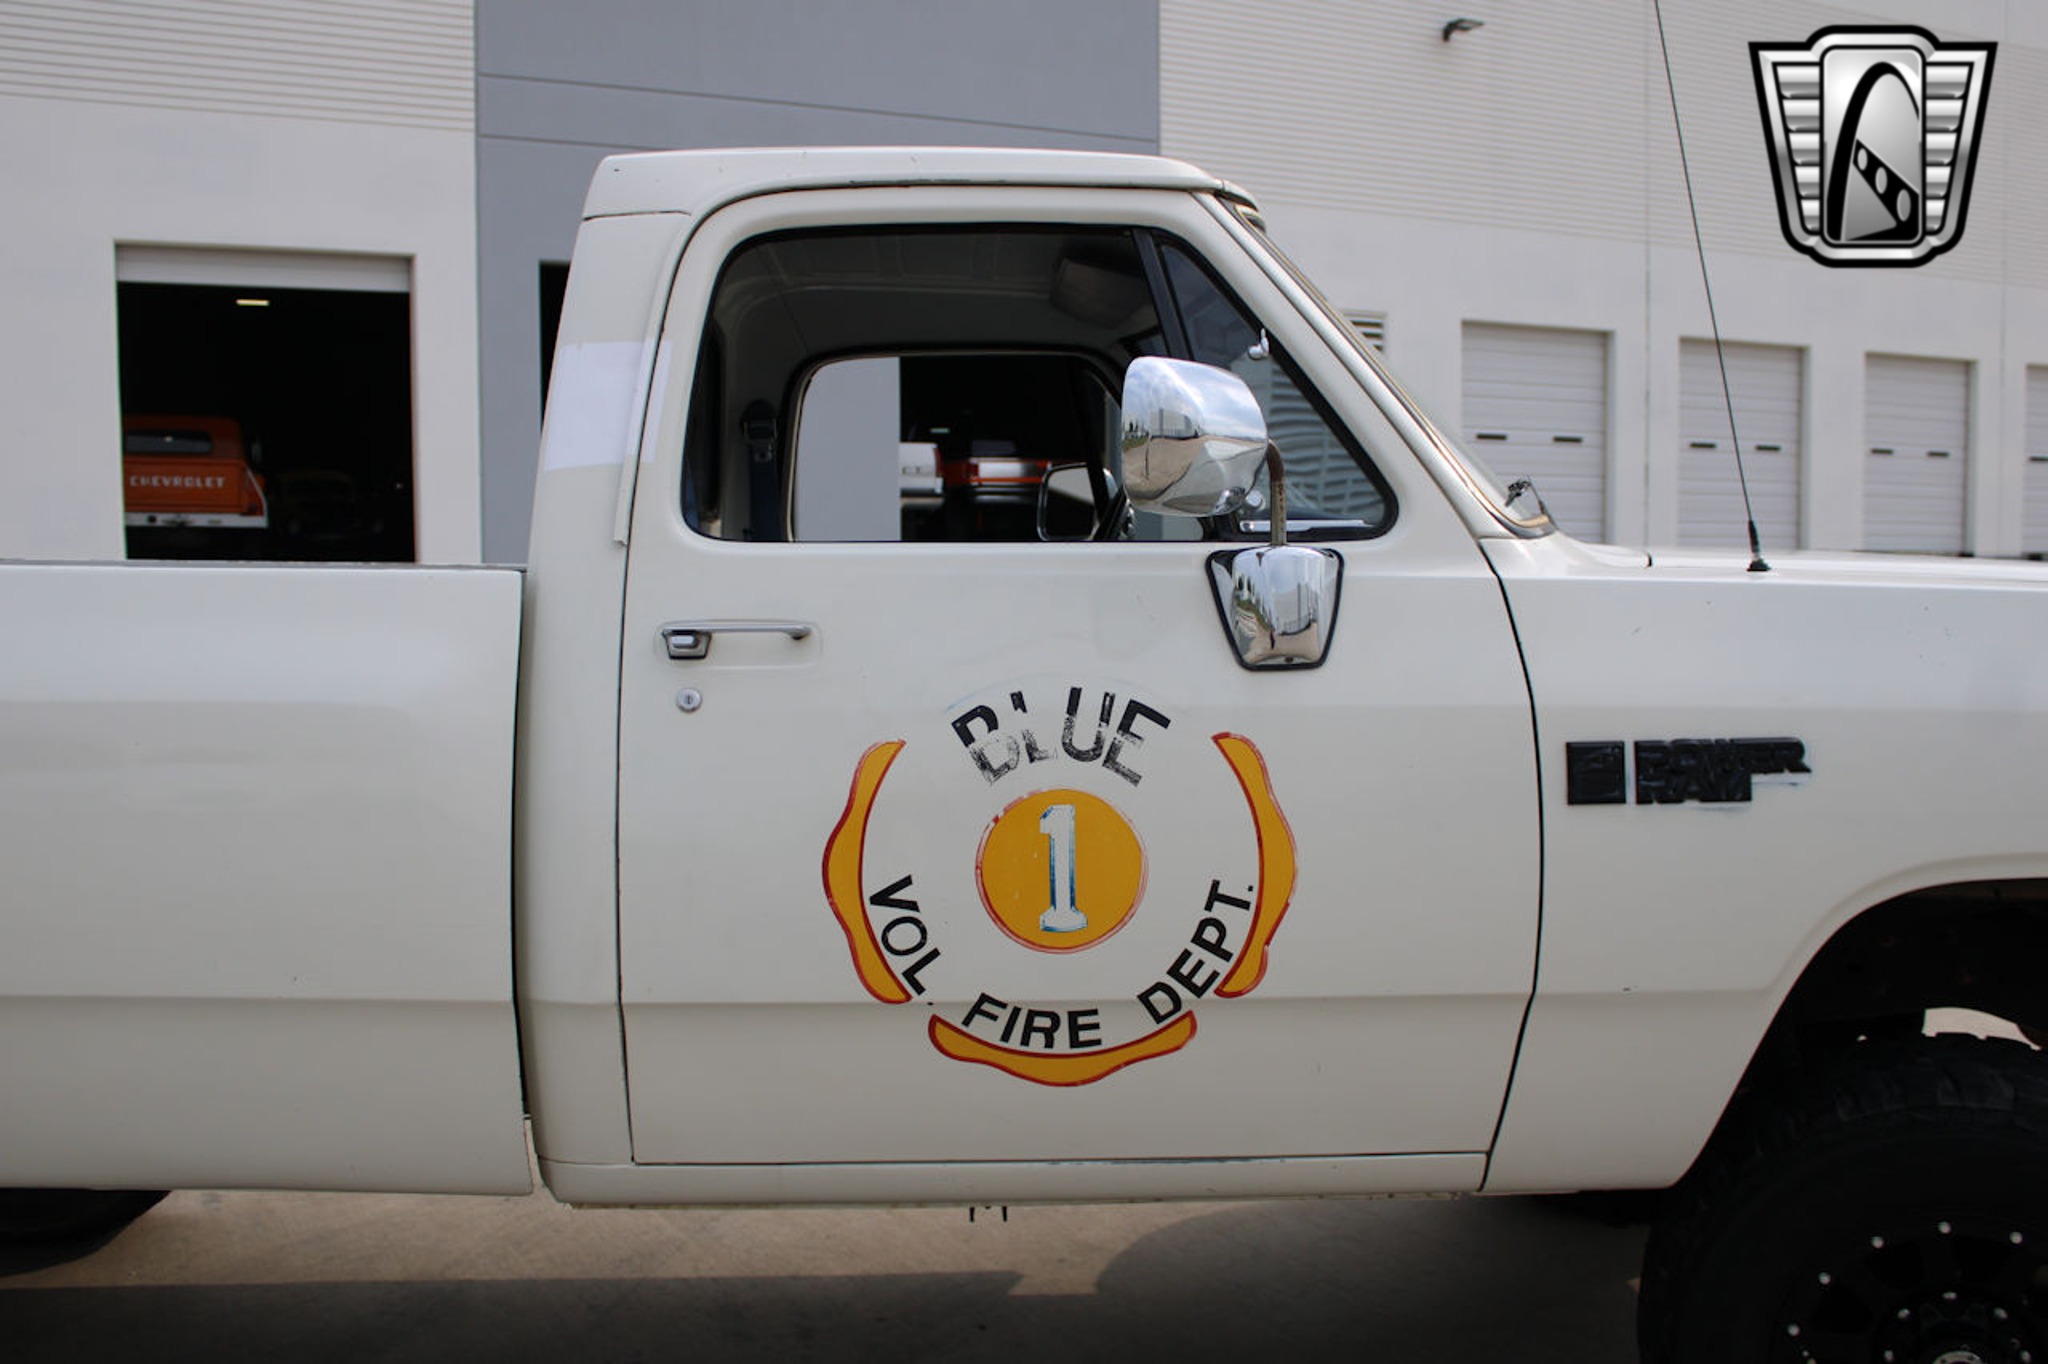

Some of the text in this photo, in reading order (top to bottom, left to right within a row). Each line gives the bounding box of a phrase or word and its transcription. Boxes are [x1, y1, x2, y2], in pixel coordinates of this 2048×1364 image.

[130, 475, 225, 488] CHEVROLET
[951, 687, 1171, 787] BLUE
[1039, 804, 1088, 932] 1
[961, 992, 1102, 1049] FIRE
[1137, 879, 1254, 1024] DEPT.
